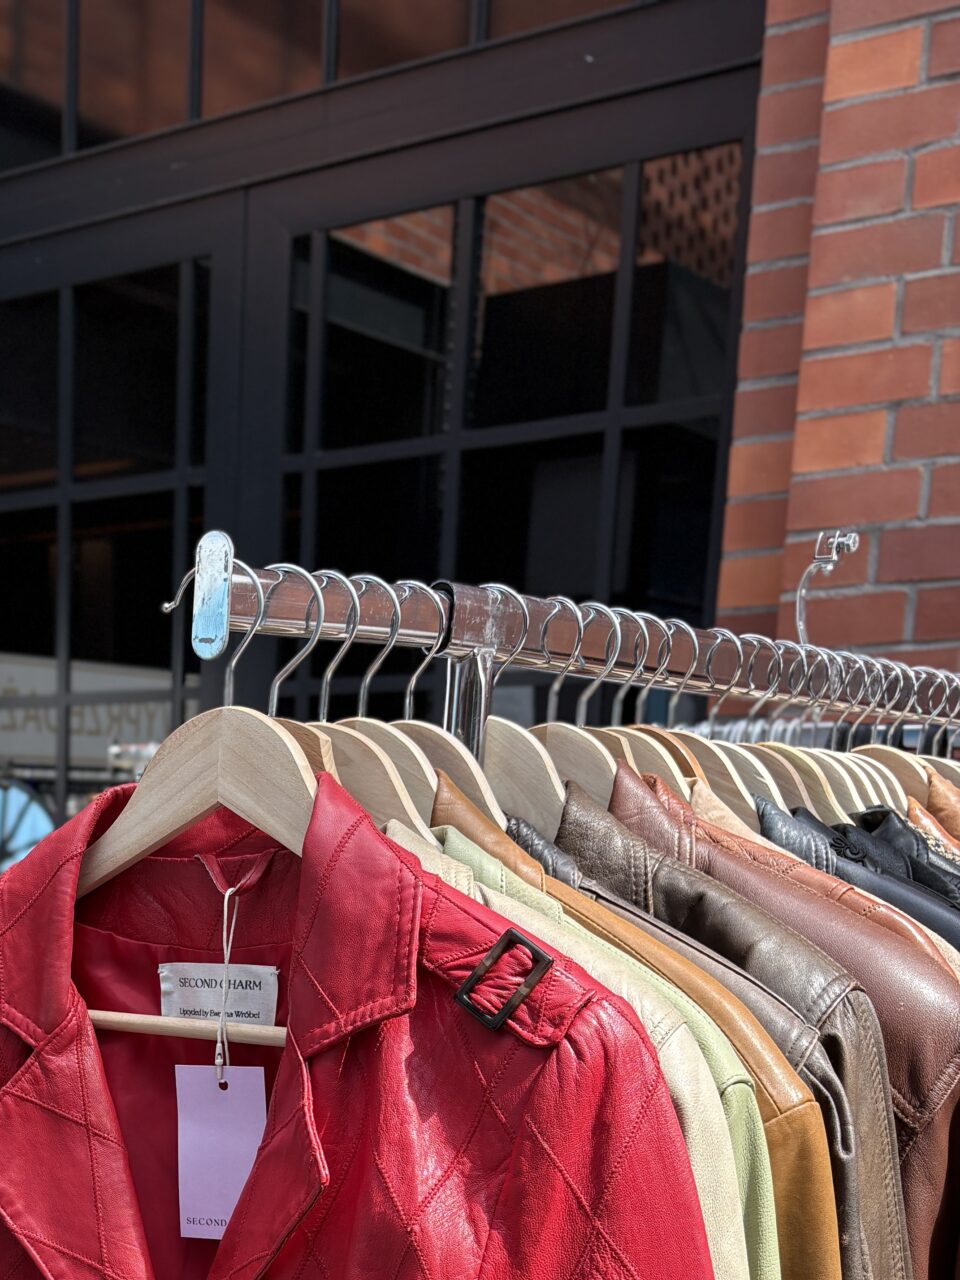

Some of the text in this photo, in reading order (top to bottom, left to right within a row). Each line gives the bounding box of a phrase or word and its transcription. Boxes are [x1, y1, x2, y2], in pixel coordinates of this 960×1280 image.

[178, 977, 217, 989] SECOND
[202, 1009, 209, 1018] by
[186, 1217, 227, 1227] SECOND
